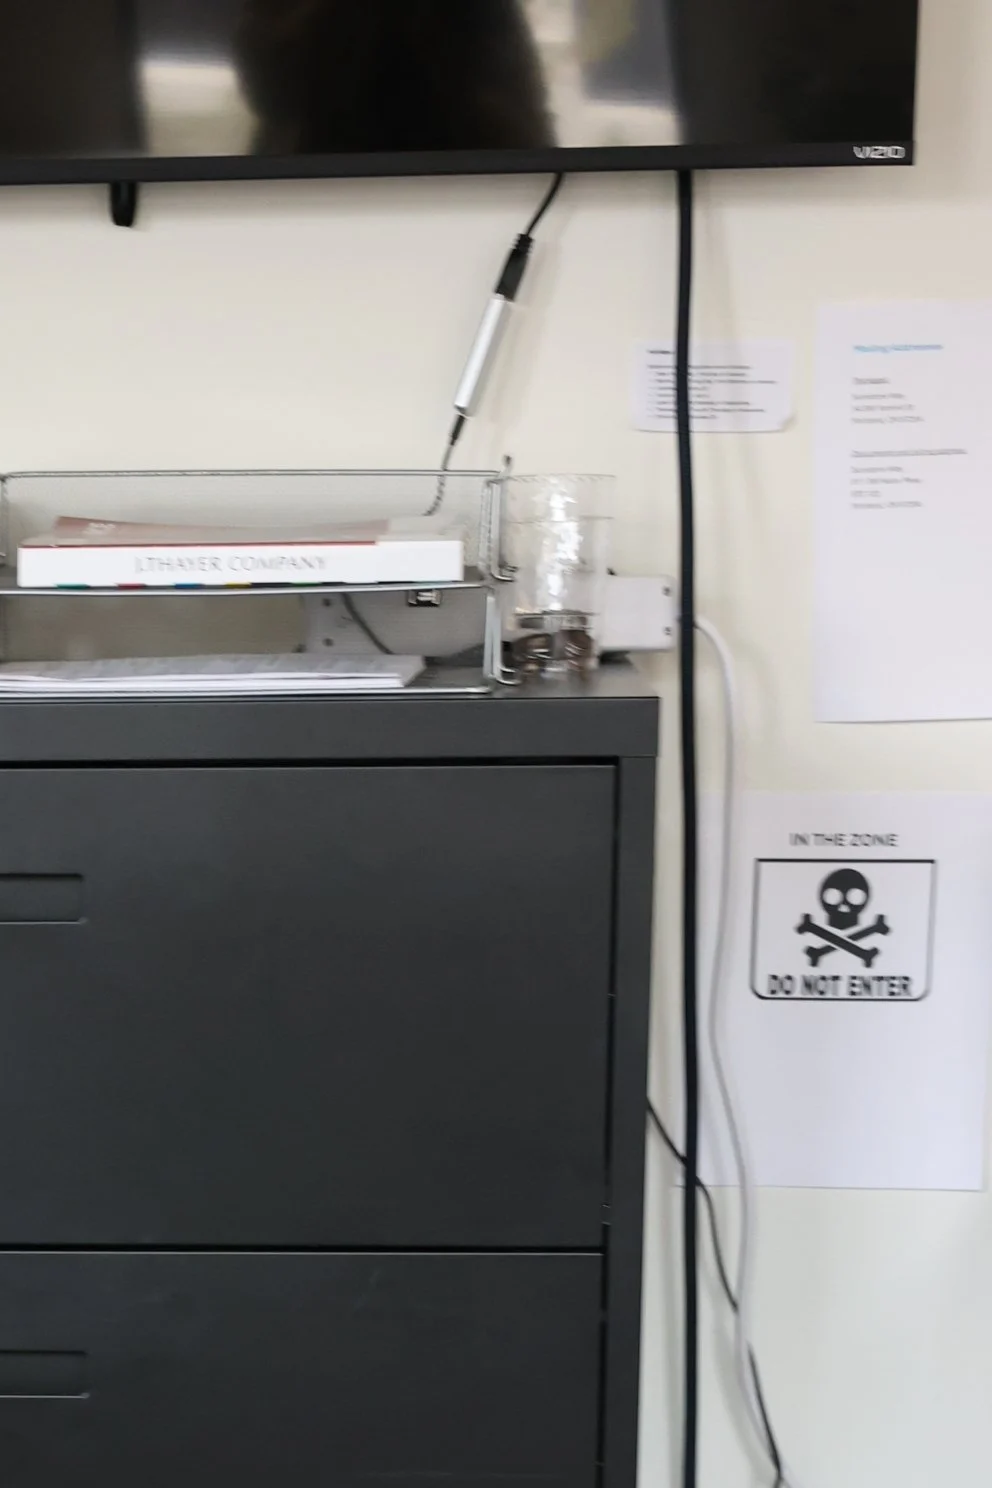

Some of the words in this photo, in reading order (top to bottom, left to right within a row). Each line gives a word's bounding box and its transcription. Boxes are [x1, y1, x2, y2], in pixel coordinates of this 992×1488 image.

[853, 146, 906, 159] VIZIO
[227, 556, 328, 572] COMPANY
[789, 833, 809, 847] IN
[811, 832, 847, 847] THE
[850, 832, 898, 847] ZONE
[768, 974, 796, 996] DO
[801, 974, 842, 996] NOT
[847, 975, 913, 997] ENTER
